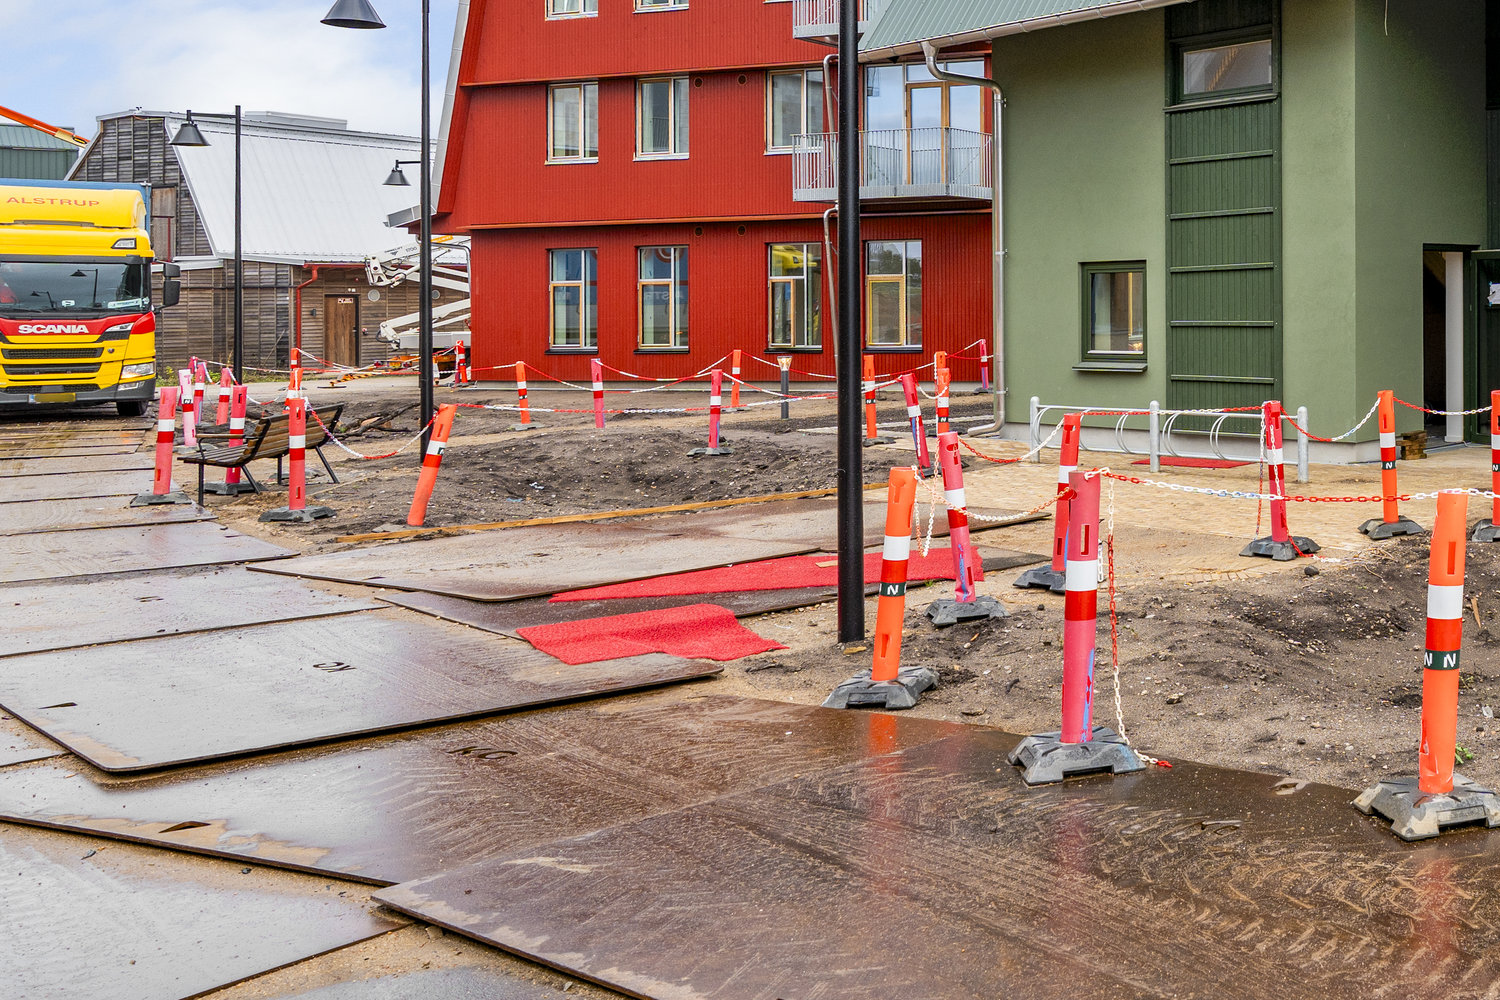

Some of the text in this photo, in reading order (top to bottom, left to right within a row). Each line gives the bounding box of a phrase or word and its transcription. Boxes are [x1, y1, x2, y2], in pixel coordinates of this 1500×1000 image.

[7, 197, 100, 206] ALSTRUP
[18, 324, 89, 334] SCANIA
[1385, 461, 1393, 470] N
[887, 584, 899, 596] N
[1424, 651, 1456, 668] N N
